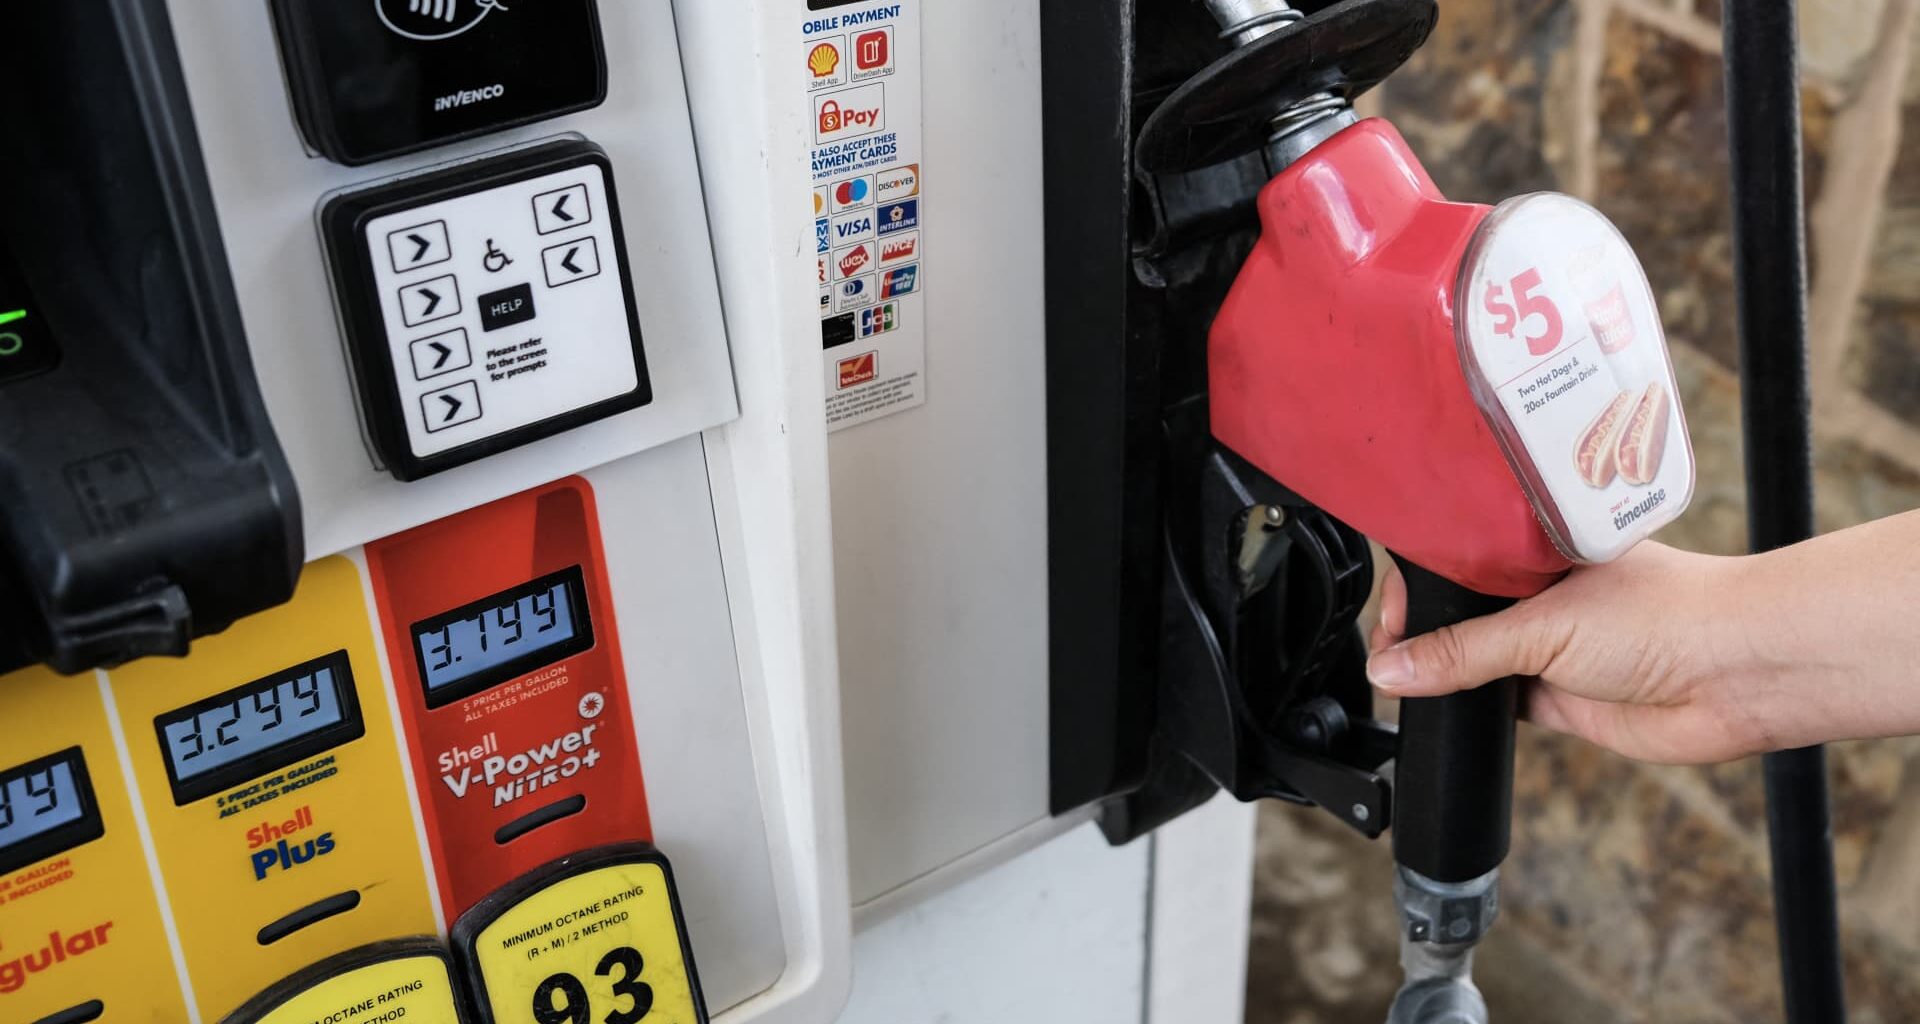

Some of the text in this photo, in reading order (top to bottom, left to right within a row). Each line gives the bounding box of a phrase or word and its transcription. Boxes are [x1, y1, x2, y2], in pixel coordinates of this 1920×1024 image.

[803, 5, 901, 34] OBILE PAYMENT
[843, 108, 879, 127] Pay
[812, 143, 897, 171] AYMENT CARDS
[819, 146, 840, 158] ALSO
[843, 139, 871, 152] ACCEPT
[874, 133, 896, 146] THESE
[818, 171, 832, 180] MOST
[834, 166, 850, 175] OTHER
[878, 176, 914, 191] DISCOVER
[836, 218, 871, 237] VISA
[880, 217, 916, 232] INTERLINK
[883, 240, 914, 254] NYCE
[491, 299, 522, 316] HELP
[862, 308, 893, 331] JCB
[1484, 267, 1563, 356] $5
[486, 349, 547, 371] to the screen
[487, 338, 542, 359] Please refer
[490, 360, 547, 381] for prompts
[1517, 357, 1579, 398] Two Hot Dogs &
[1523, 363, 1599, 414] 20oz Fountain Drink
[1613, 488, 1666, 531] timewise
[465, 676, 569, 723] ALL TAXES INCLUDED
[474, 691, 500, 707] PRICE
[504, 683, 522, 695] PER
[526, 666, 567, 686] GALLON
[179, 672, 320, 761] 3.299
[438, 732, 497, 773] Shell
[442, 723, 597, 798] V-Power
[219, 767, 338, 819] ALL TAXES INCLUDED
[228, 784, 260, 803] PRICE
[264, 775, 284, 789] PER
[287, 755, 335, 779] GALLON
[246, 805, 313, 849] Shell
[15, 858, 70, 884] GALLON
[251, 832, 335, 881] Plus
[8, 870, 73, 900] INCLUDED
[503, 886, 644, 949] MINIMUM OCTANE RATING
[573, 932, 580, 941] 2
[583, 911, 629, 936] METHOD
[0, 920, 113, 993] gular
[323, 980, 423, 1024] OCTANE RATING
[533, 946, 653, 1024] 93
